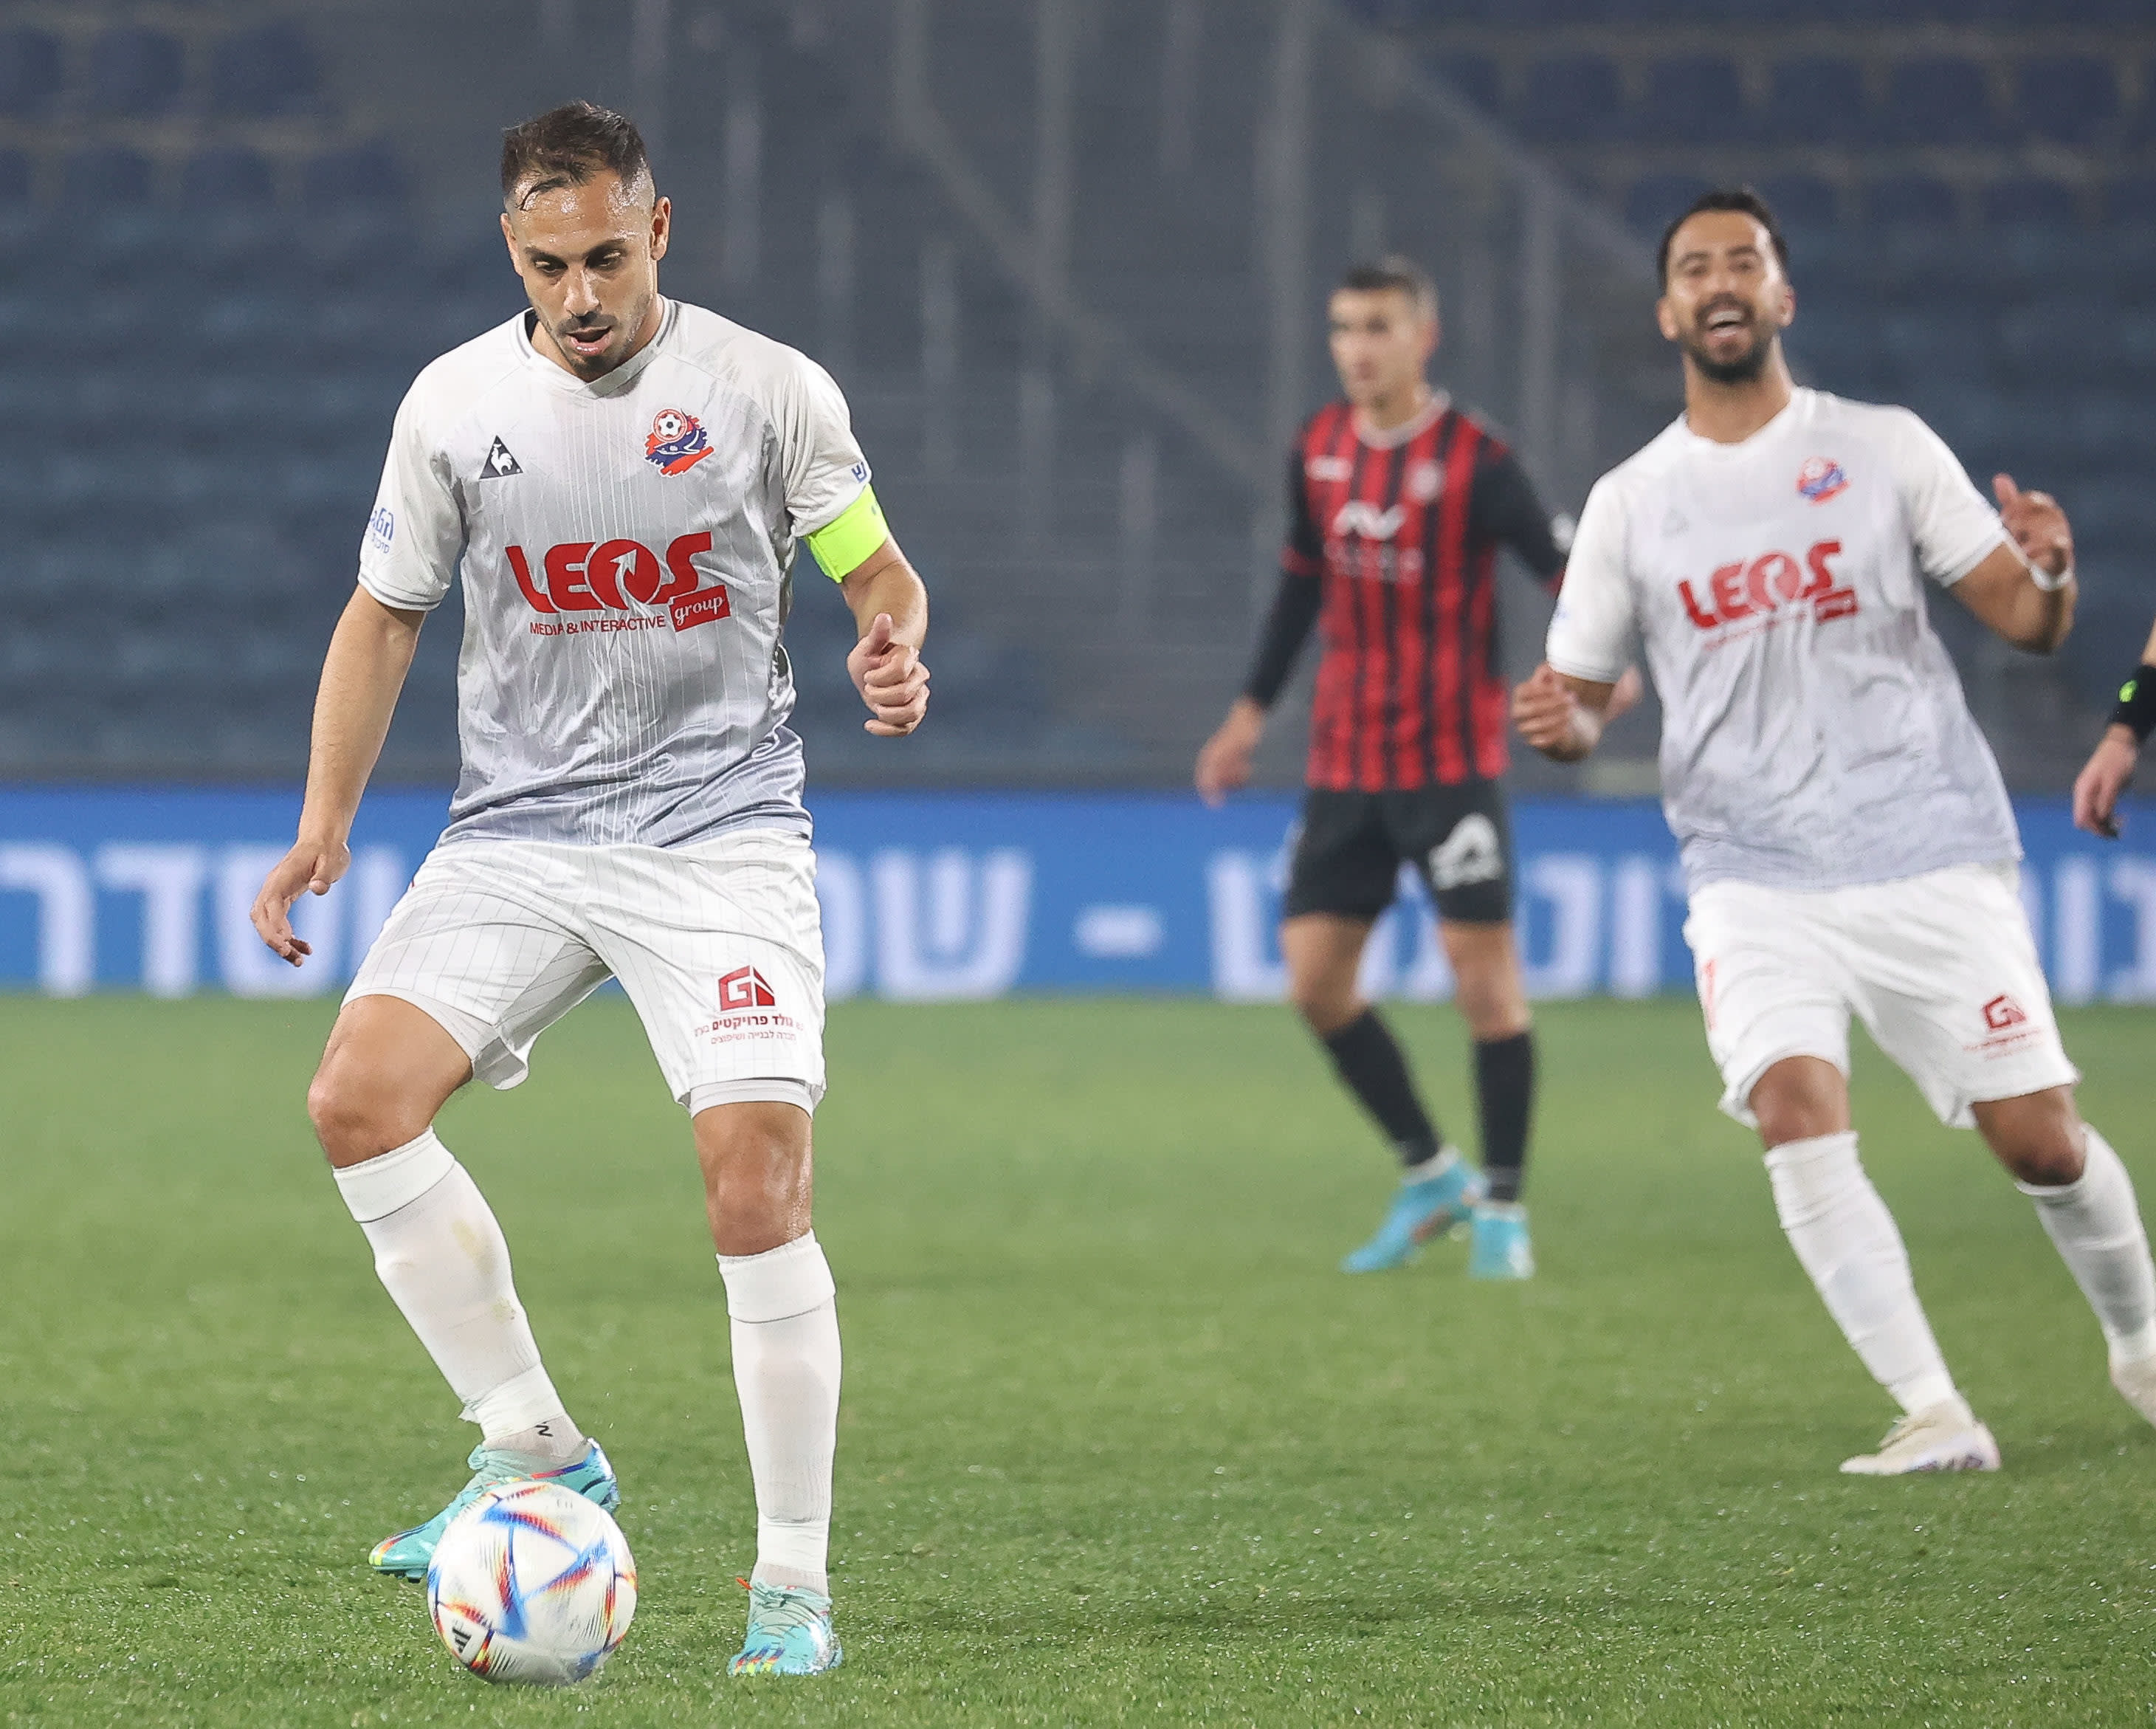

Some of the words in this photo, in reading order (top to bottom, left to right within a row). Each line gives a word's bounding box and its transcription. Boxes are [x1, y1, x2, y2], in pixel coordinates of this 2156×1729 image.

[505, 531, 712, 613] LEOS
[1678, 543, 1841, 628] LEOS
[530, 622, 564, 636] MEDIA
[567, 622, 579, 634] &
[581, 616, 665, 633] INTERACTIVE
[674, 597, 724, 626] group
[712, 1015, 768, 1031] פרויקטים
